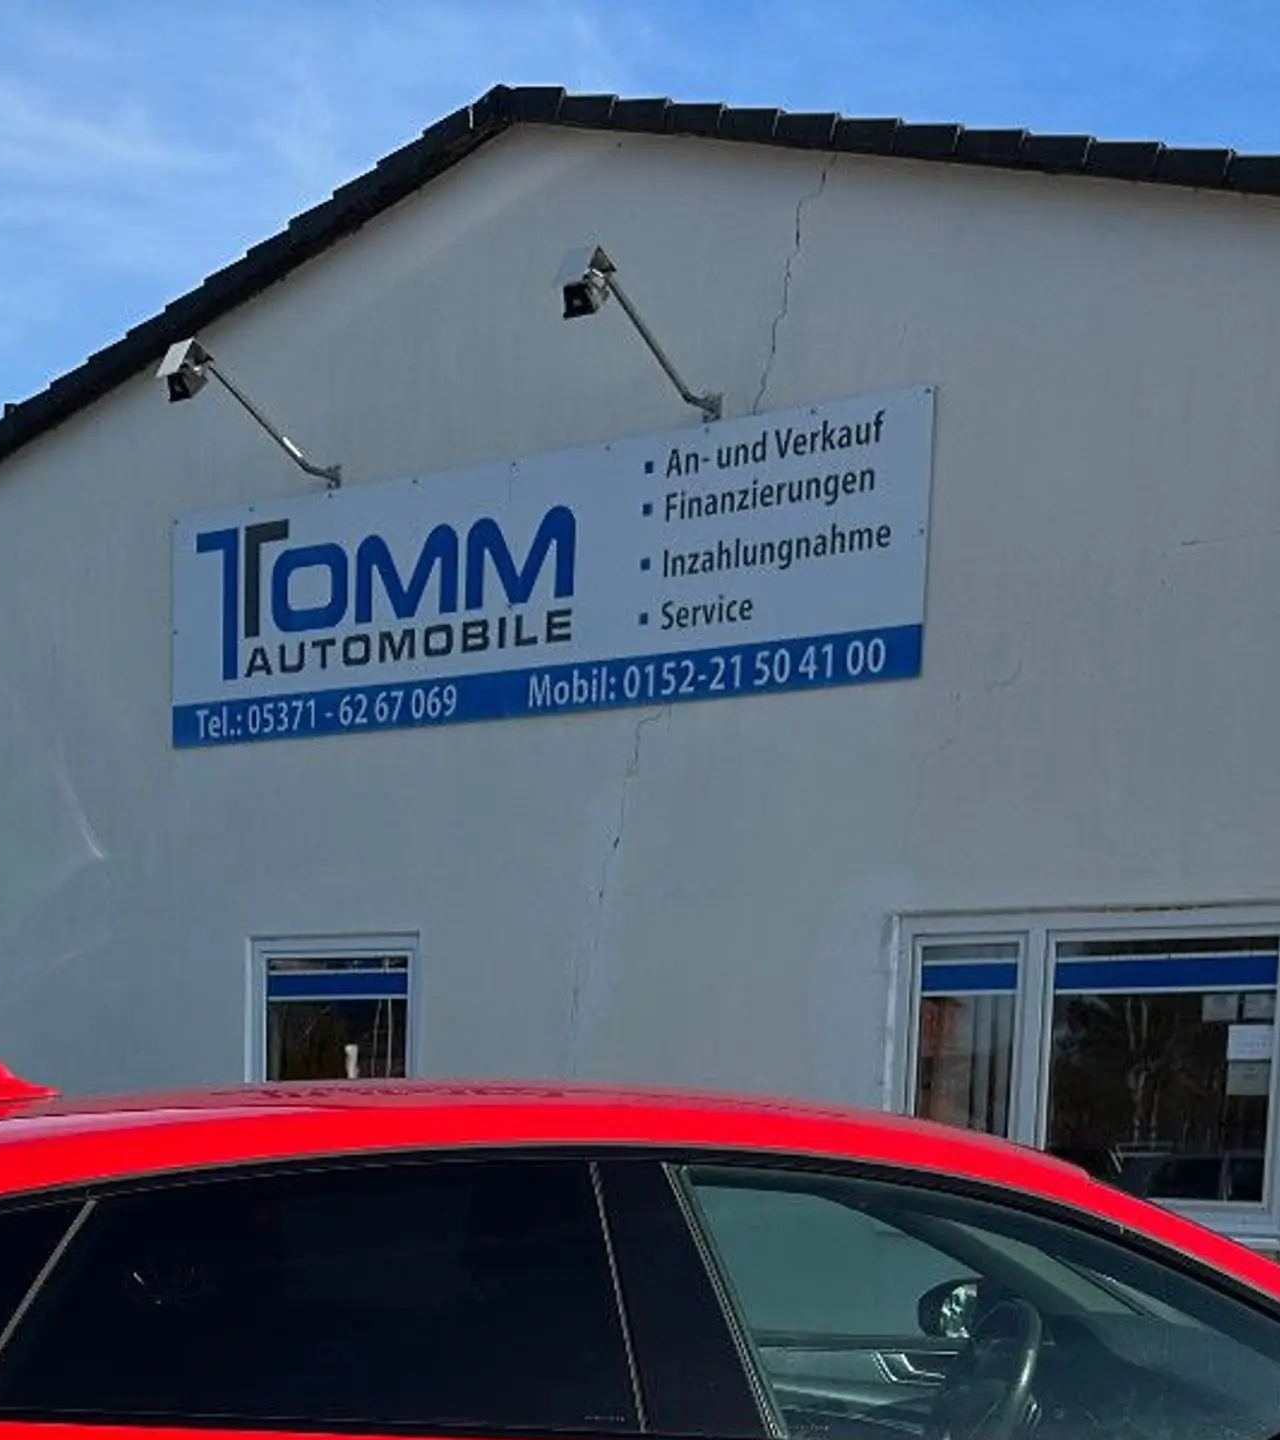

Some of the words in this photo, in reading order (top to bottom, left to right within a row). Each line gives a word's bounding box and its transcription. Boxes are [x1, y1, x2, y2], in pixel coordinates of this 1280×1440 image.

[666, 448, 711, 479] An-
[717, 430, 767, 470] und
[775, 410, 886, 459] Verkauf
[664, 467, 876, 523] Finanzierungen
[662, 523, 892, 579] Inzahlungnahme
[660, 595, 754, 631] Service
[244, 608, 573, 678] AUTOMOBILE
[528, 668, 617, 708] Mobil:
[623, 654, 743, 699] 0152-21
[753, 646, 791, 686] 50
[799, 641, 834, 679] 41
[846, 636, 886, 676] 00
[248, 700, 316, 735] 05371
[338, 695, 369, 727] 62
[371, 691, 405, 723] 67
[411, 685, 457, 719] 069
